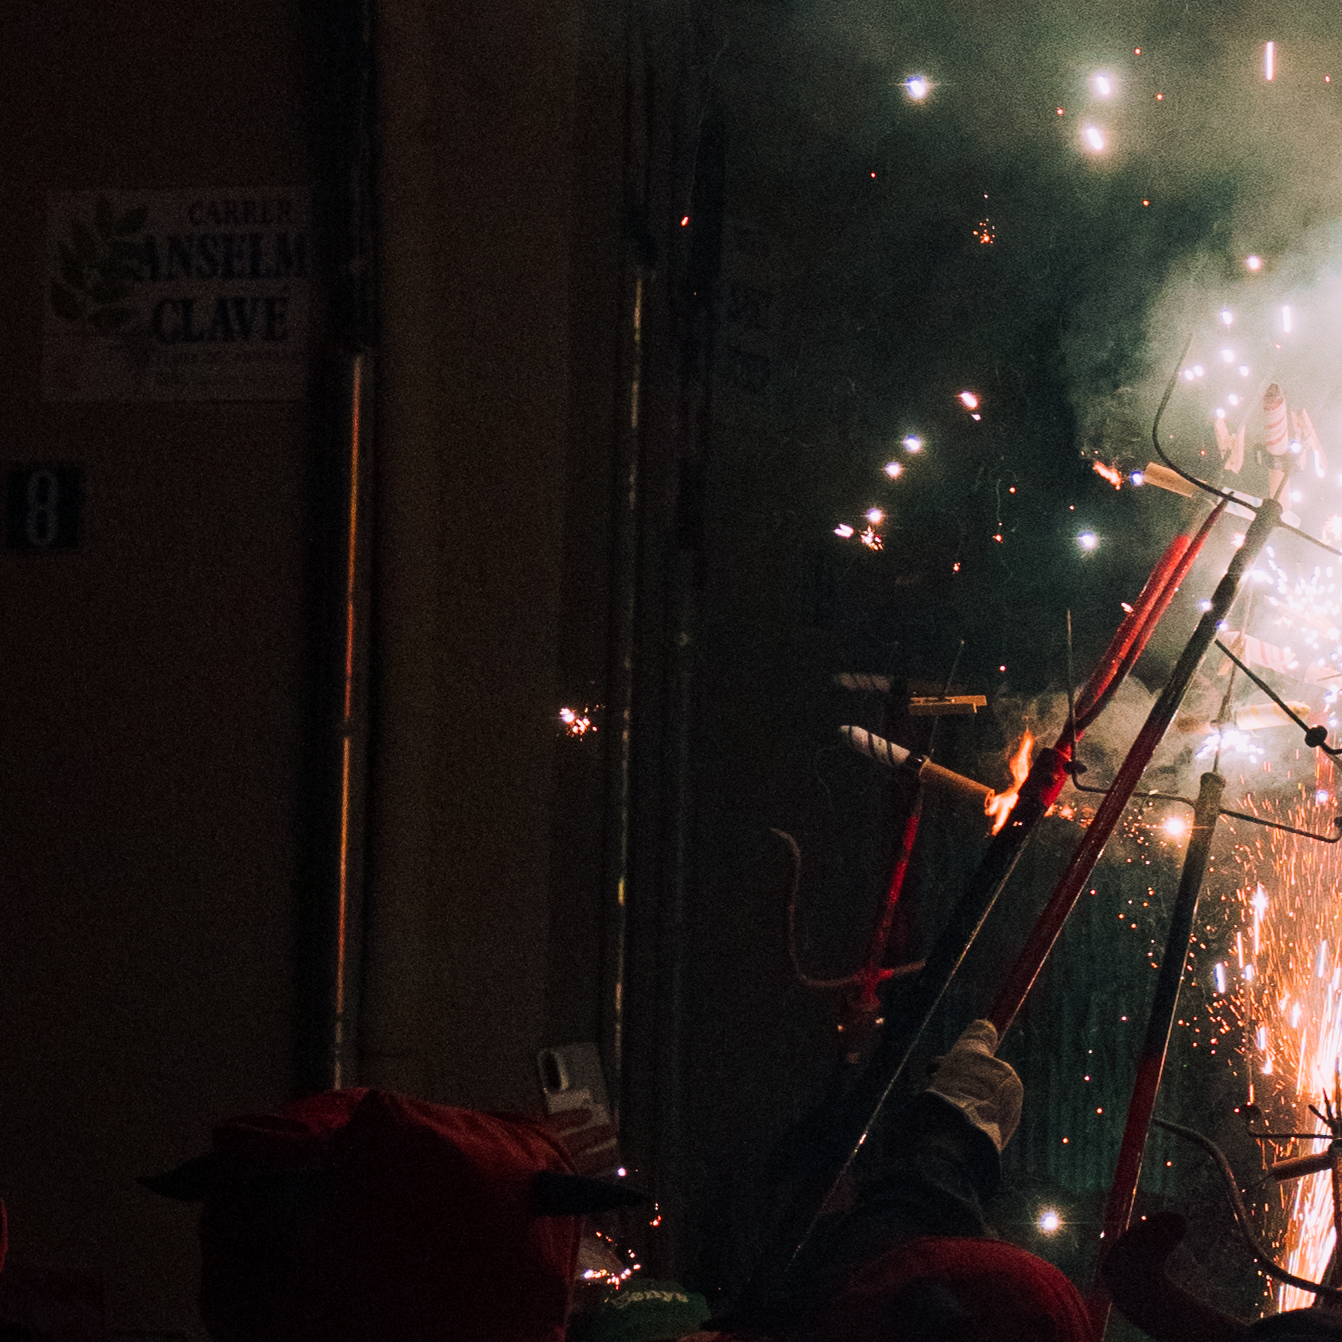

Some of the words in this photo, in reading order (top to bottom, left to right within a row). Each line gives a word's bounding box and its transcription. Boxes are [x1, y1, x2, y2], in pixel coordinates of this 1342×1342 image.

[189, 199, 292, 227] CARRER
[132, 234, 311, 282] ANSELM
[27, 470, 59, 546] 8
